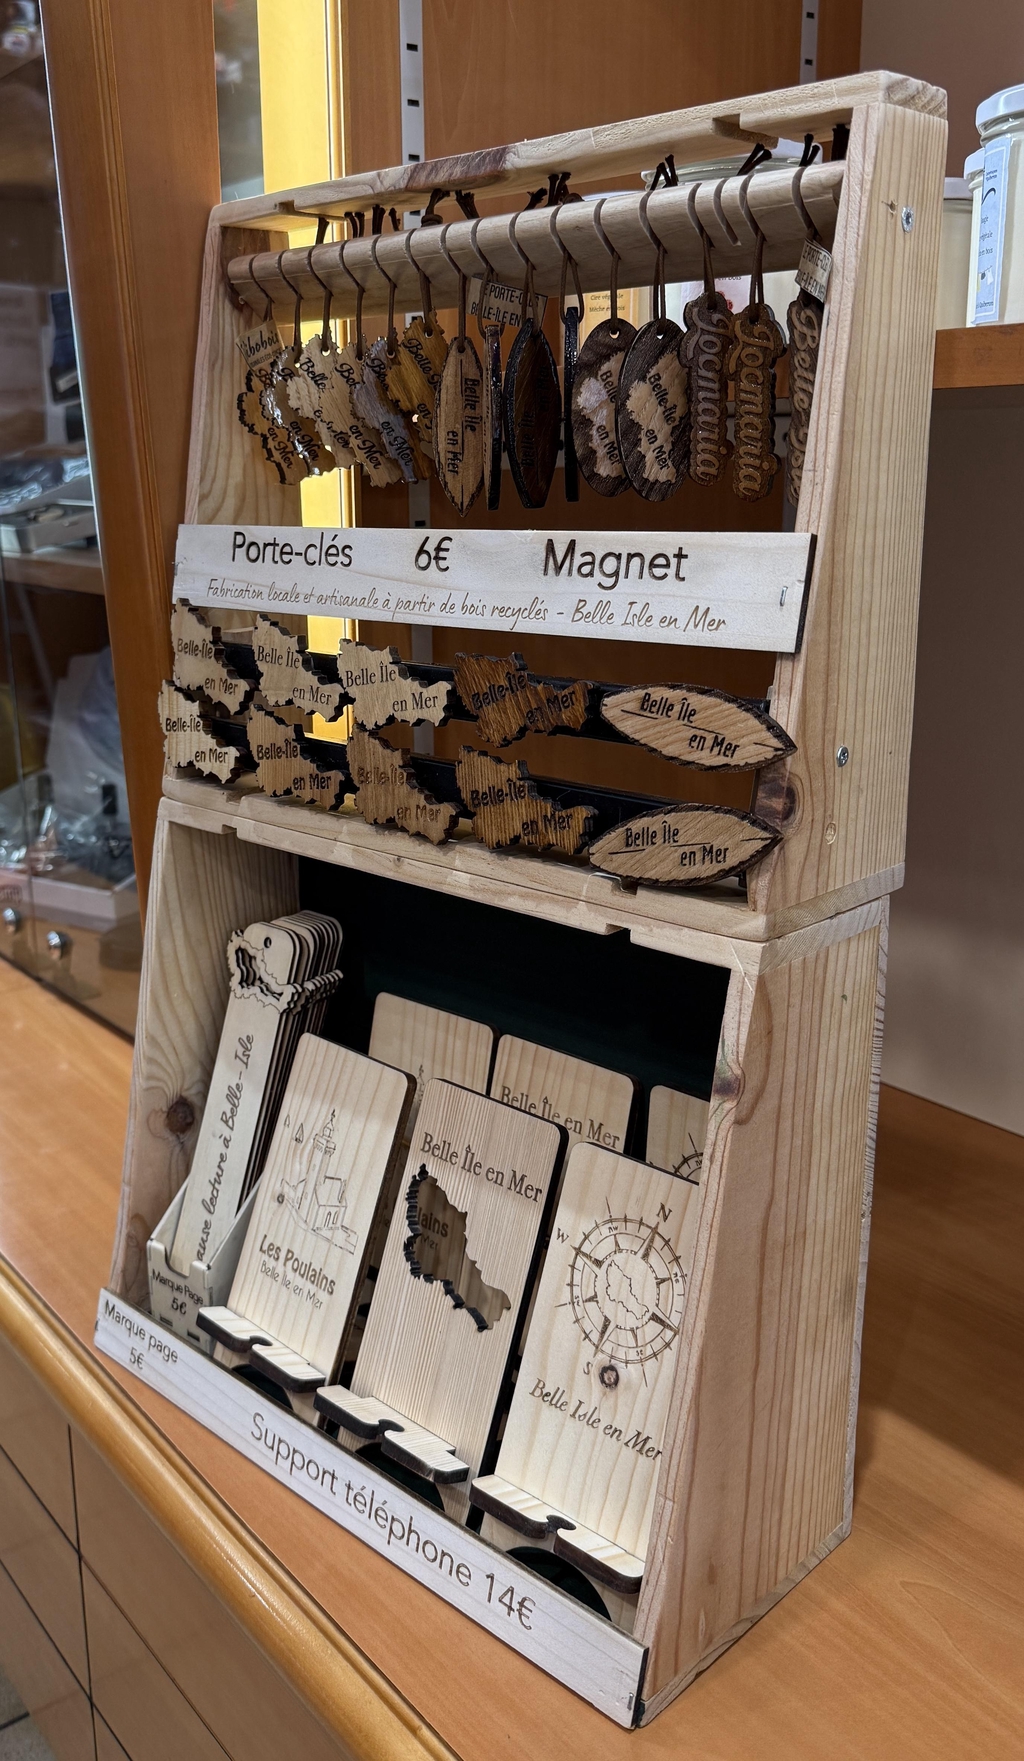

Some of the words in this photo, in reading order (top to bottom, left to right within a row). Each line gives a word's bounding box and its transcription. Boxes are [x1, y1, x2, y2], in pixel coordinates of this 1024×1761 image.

[402, 338, 433, 375] Belle
[464, 378, 480, 411] Belle
[596, 424, 610, 440] en
[349, 424, 363, 441] en
[357, 440, 382, 470] Mer
[645, 429, 658, 445] en
[653, 445, 671, 471] Mer
[232, 531, 353, 569] Porte-clés
[414, 536, 453, 573] 6€
[543, 538, 689, 591] Magnet
[207, 579, 265, 601] Fabrication
[267, 581, 300, 603] locale
[303, 592, 316, 605] et
[316, 588, 380, 610] artisanale
[382, 592, 392, 610] à
[393, 595, 436, 621] partir
[440, 593, 457, 615] de
[461, 592, 487, 617] bois
[490, 597, 549, 631] recyclés
[571, 598, 615, 626] Belle
[621, 601, 653, 628] Isle
[659, 613, 681, 630] en
[683, 605, 728, 632] Mer
[257, 645, 284, 666] Belle
[285, 647, 300, 670] Île
[204, 676, 218, 692] en
[218, 678, 239, 696] Mer
[346, 668, 376, 688] Belle
[379, 661, 397, 682] Île
[292, 686, 307, 701] en
[308, 685, 332, 706] Mer
[392, 699, 408, 713] en
[411, 694, 439, 711] Mer
[640, 692, 675, 719] Belle
[677, 698, 698, 725] Île
[194, 749, 207, 763] en
[208, 747, 229, 764] Mer
[688, 731, 707, 752] en
[711, 733, 740, 760] Mer
[293, 776, 307, 790] en
[308, 772, 332, 790] Mer
[396, 806, 412, 821] en
[414, 803, 442, 823] Mer
[521, 819, 539, 838] en
[543, 812, 574, 834] Mer
[625, 825, 659, 849] Belle
[661, 819, 680, 844] Île
[680, 848, 698, 868] en
[701, 844, 731, 866] Mer
[501, 1085, 537, 1114] Belle
[564, 1117, 583, 1136] en
[586, 1118, 620, 1149] Mer
[219, 1134, 232, 1150] à
[420, 1132, 458, 1166] Belle
[461, 1144, 482, 1177] Île
[485, 1167, 506, 1187] en
[507, 1169, 543, 1203] Mer
[202, 1151, 228, 1216] lecture
[656, 1202, 673, 1222] N
[196, 1219, 212, 1262] ause
[556, 1227, 570, 1245] W
[259, 1234, 281, 1261] Les
[283, 1248, 336, 1296] Poulains
[260, 1260, 280, 1282] Belle
[293, 1284, 304, 1298] en
[152, 1268, 184, 1294] Marque
[184, 1284, 204, 1306] Page
[171, 1296, 187, 1316] 5€
[104, 1298, 146, 1341] Marque
[148, 1334, 179, 1363] page
[129, 1346, 145, 1370] 5€
[583, 1361, 594, 1376] S
[529, 1378, 569, 1412] Belle
[570, 1399, 602, 1429] Isle
[603, 1423, 623, 1442] en
[624, 1429, 663, 1460] Mer
[251, 1412, 338, 1496] Support
[345, 1480, 472, 1587] téléphone
[485, 1572, 537, 1631] 14€
